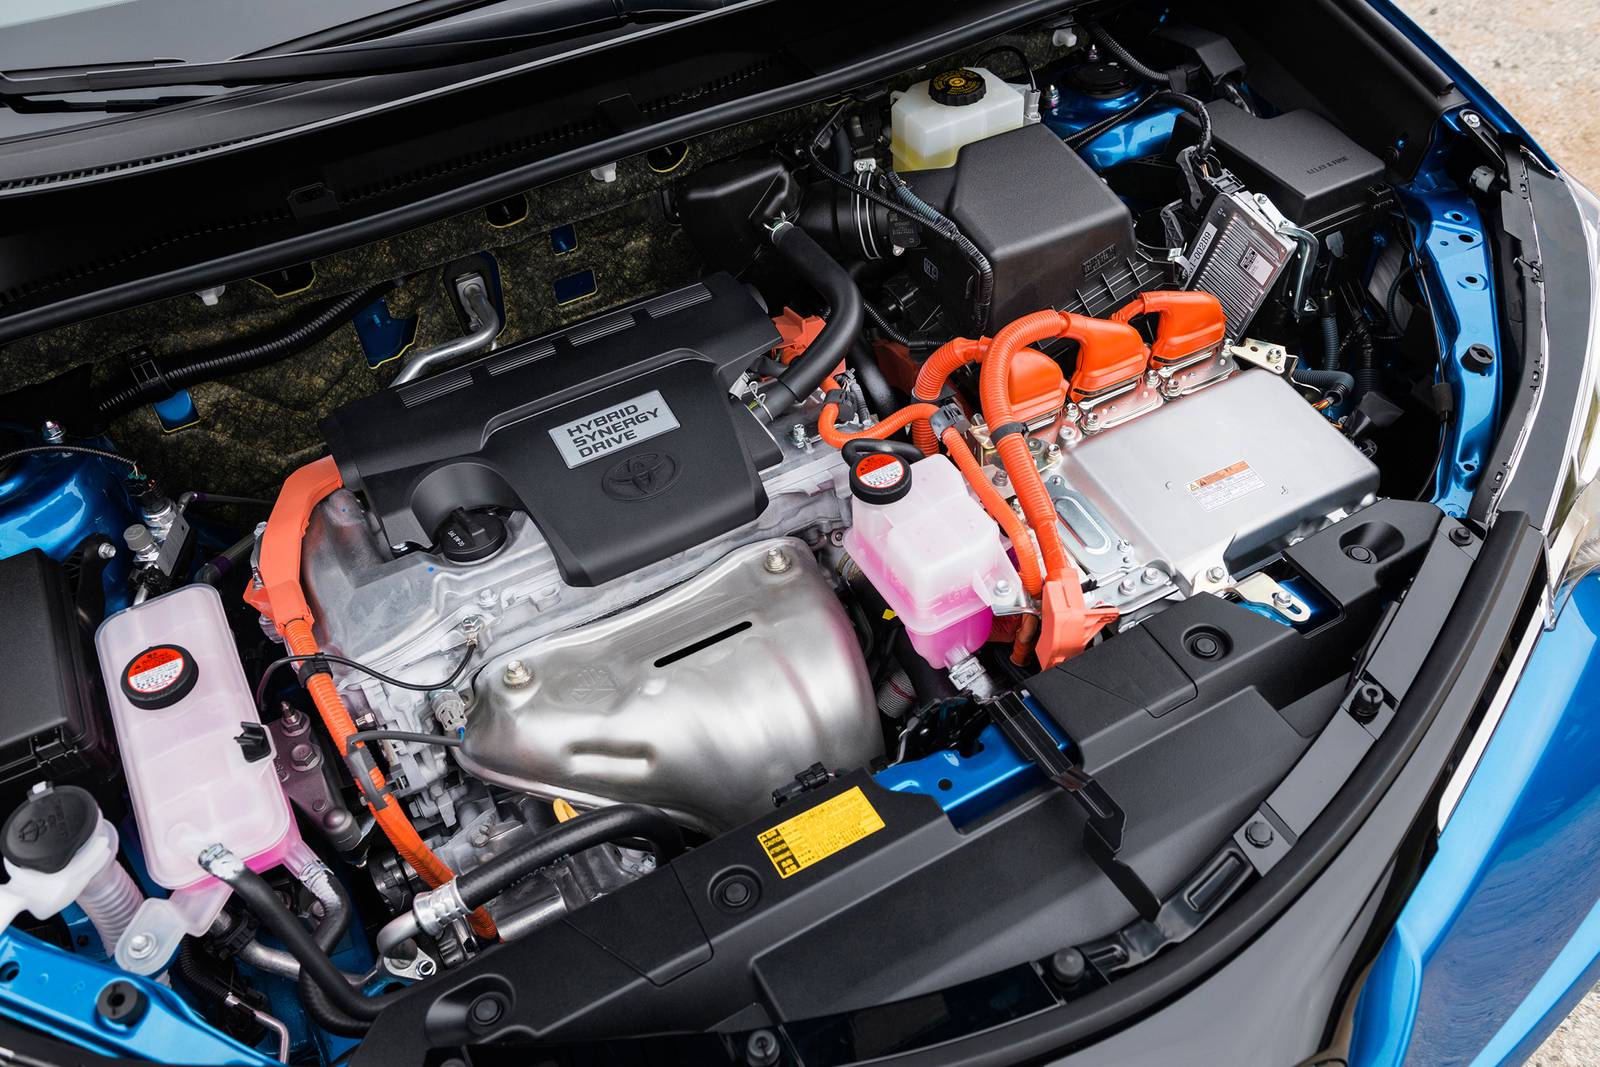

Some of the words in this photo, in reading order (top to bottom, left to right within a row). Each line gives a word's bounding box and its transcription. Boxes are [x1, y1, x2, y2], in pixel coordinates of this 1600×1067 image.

[567, 404, 639, 437] HYBRID
[573, 407, 659, 448] SYNERGY
[578, 429, 638, 458] DRIVE
